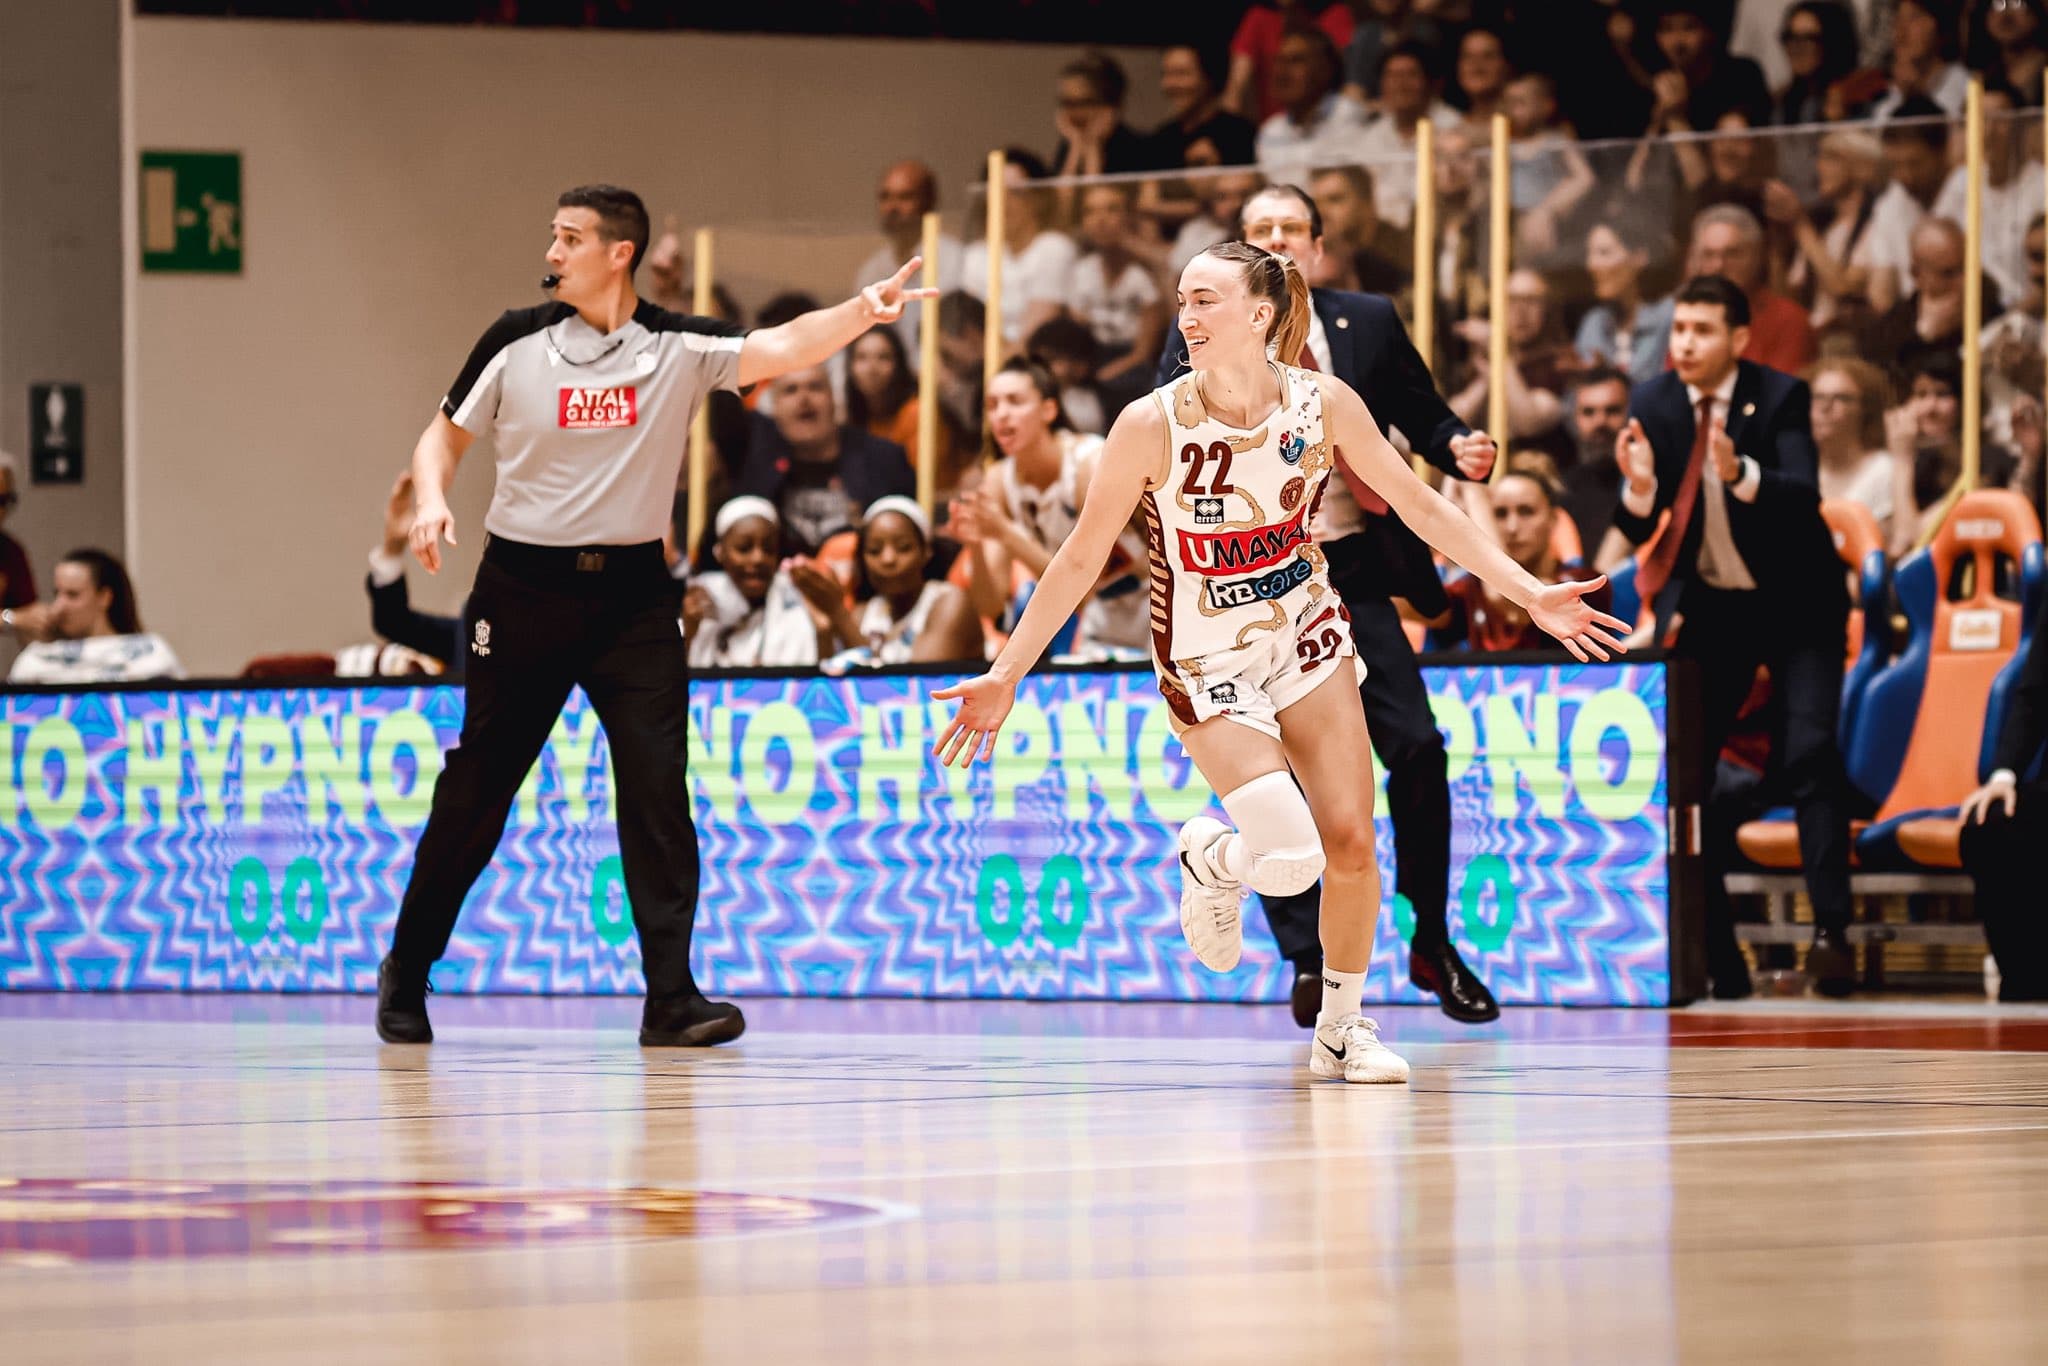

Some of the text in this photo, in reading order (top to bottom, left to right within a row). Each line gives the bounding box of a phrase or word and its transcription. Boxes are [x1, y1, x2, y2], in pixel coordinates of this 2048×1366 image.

[566, 387, 630, 408] ATTAL
[1180, 441, 1234, 495] 22
[1186, 520, 1306, 570] UMANA
[0, 714, 87, 829] O
[124, 709, 440, 828] HYPNO
